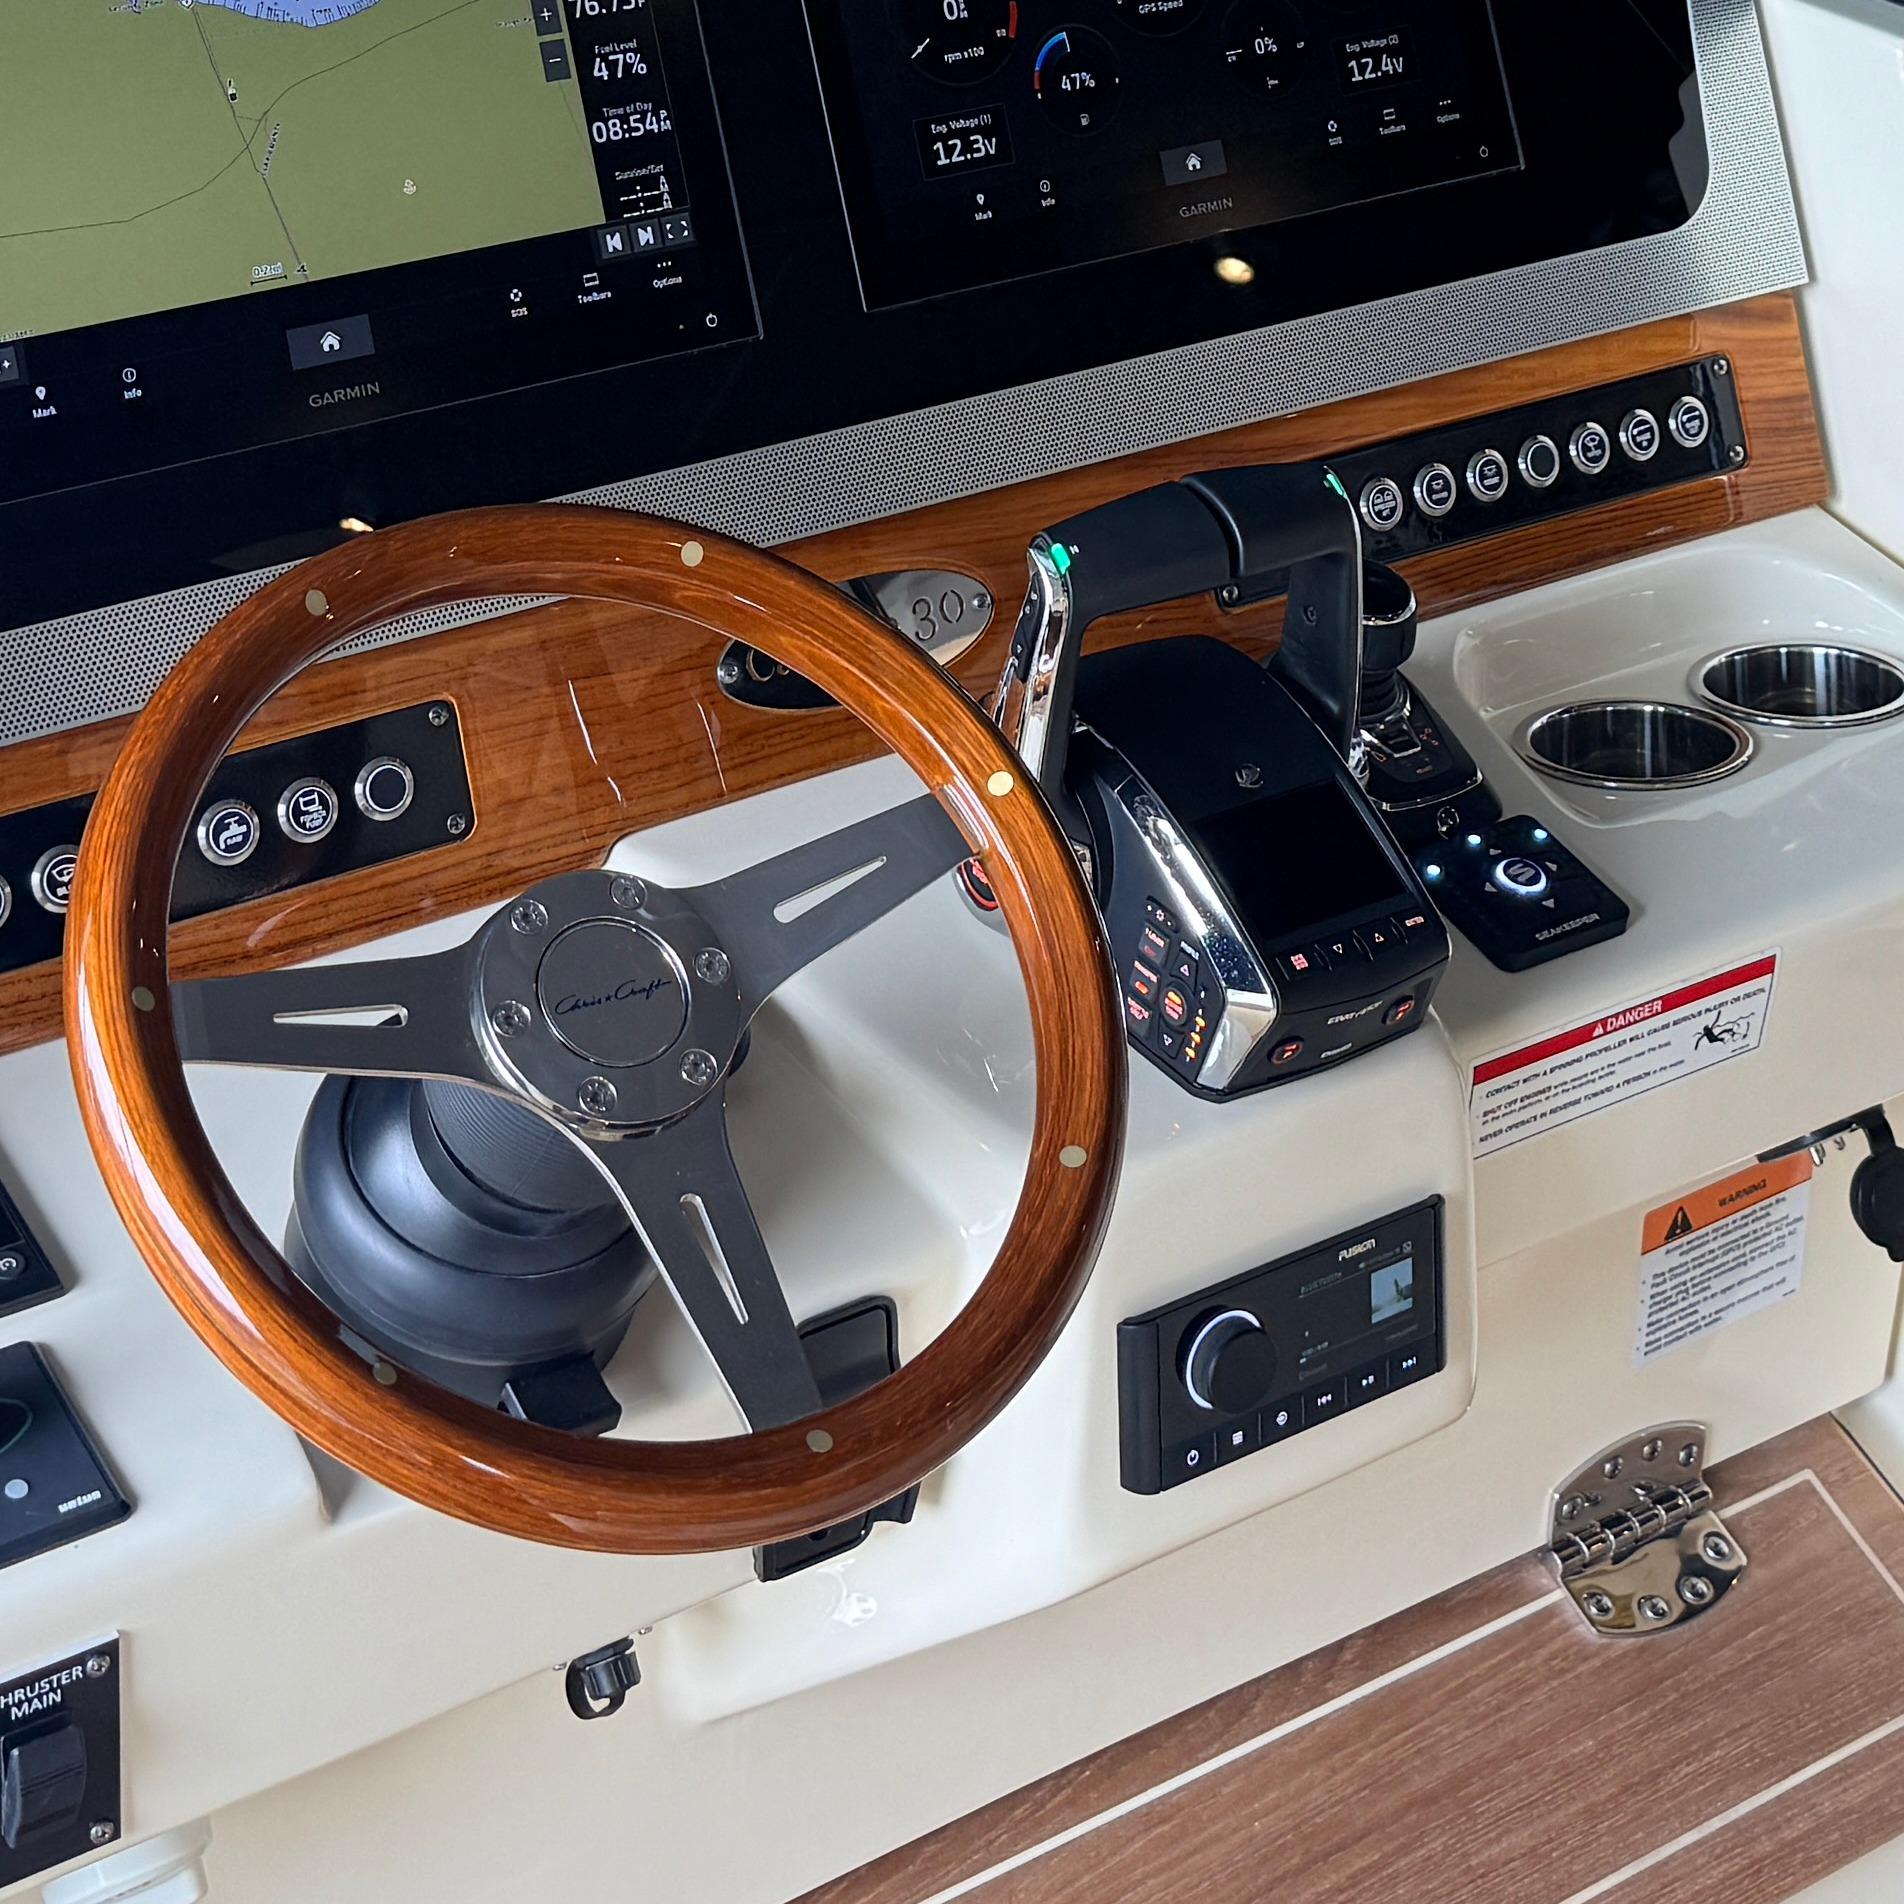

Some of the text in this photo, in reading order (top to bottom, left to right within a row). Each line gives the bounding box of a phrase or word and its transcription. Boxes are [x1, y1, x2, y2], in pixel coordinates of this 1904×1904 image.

[593, 51, 648, 81] 47%
[1060, 71, 1096, 92] 47%
[591, 111, 660, 143] 08:54
[1178, 197, 1234, 219] GARMIN
[308, 381, 382, 410] GARMIN
[911, 589, 965, 642] 30
[1534, 912, 1601, 942] SEAKEEPER
[1606, 999, 1664, 1033] DANGER
[1717, 1178, 1768, 1208] WARNING
[1337, 1238, 1377, 1262] FUSION
[10, 1688, 63, 1721] MAIN
